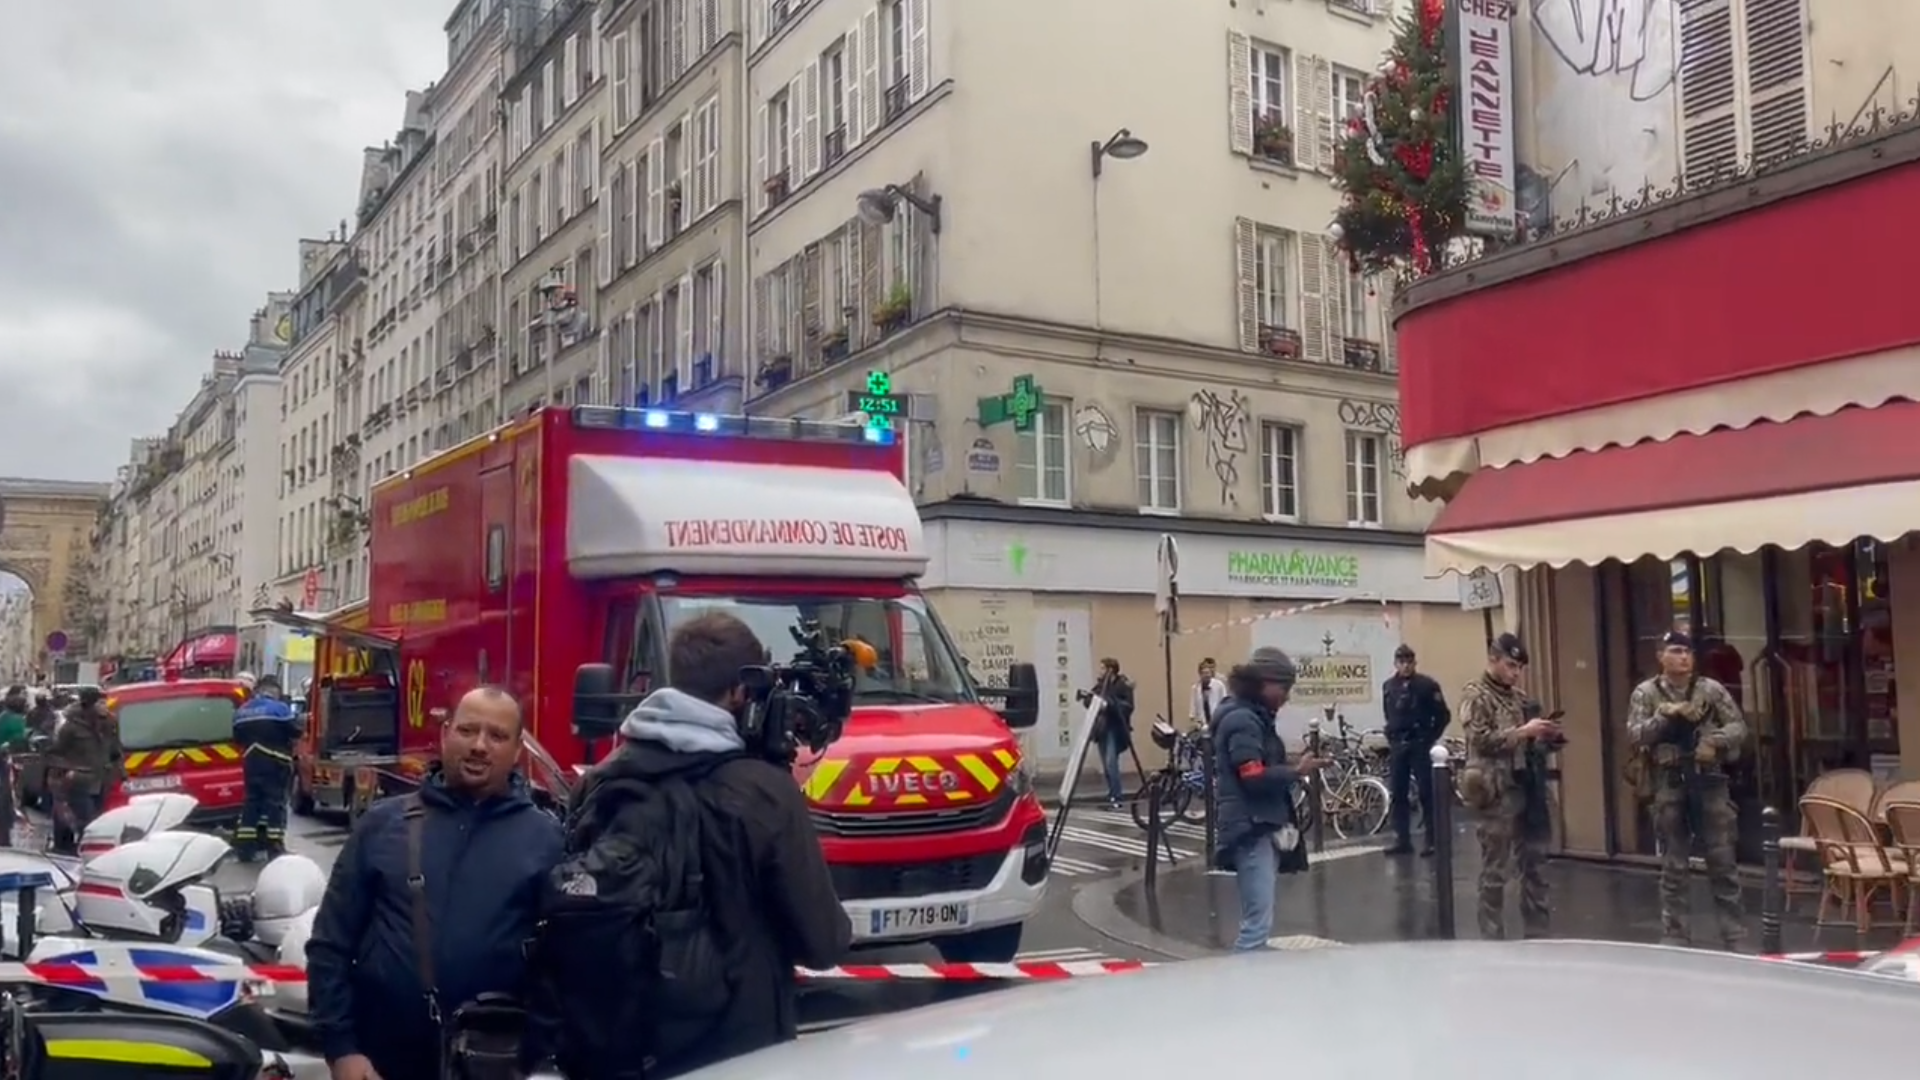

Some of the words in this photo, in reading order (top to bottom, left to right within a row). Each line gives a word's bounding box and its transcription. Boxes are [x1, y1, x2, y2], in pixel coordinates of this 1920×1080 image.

[1460, 0, 1508, 22] CHEZ
[1469, 27, 1503, 179] JEANNETTE
[859, 397, 898, 412] 12:51
[986, 644, 1014, 657] LUNDI
[982, 658, 1019, 671] SAME
[1295, 661, 1367, 679] HARMAVANCE
[988, 674, 1010, 688] 8h3
[870, 771, 958, 792] IVECO
